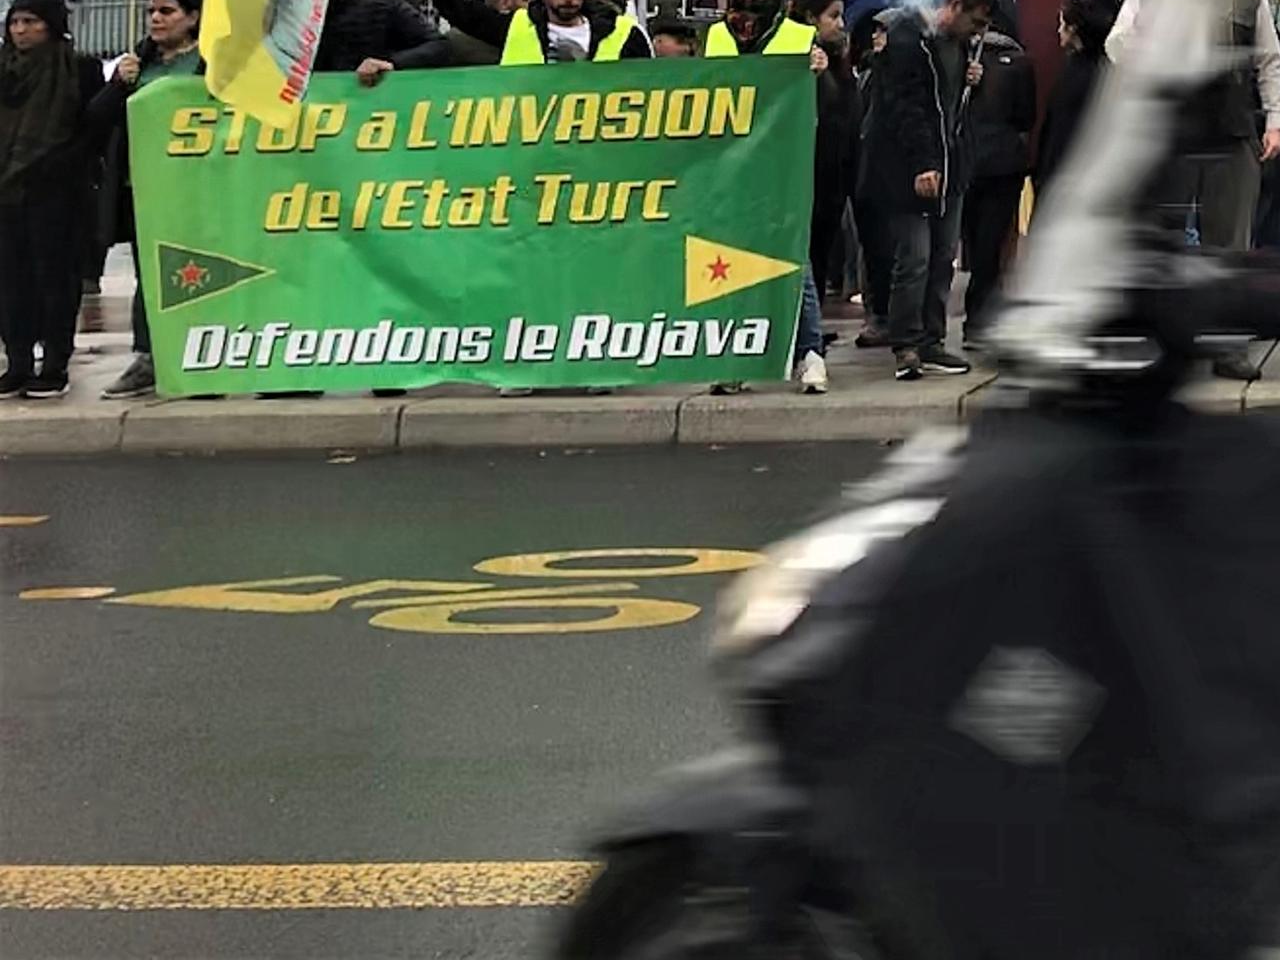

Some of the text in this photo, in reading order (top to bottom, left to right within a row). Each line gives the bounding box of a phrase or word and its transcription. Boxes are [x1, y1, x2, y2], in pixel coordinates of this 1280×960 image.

[166, 102, 348, 157] STOP
[406, 85, 757, 151] L'INVASION
[264, 173, 677, 232] de l'Etat Turc
[182, 311, 771, 372] Défendons le Rojava
